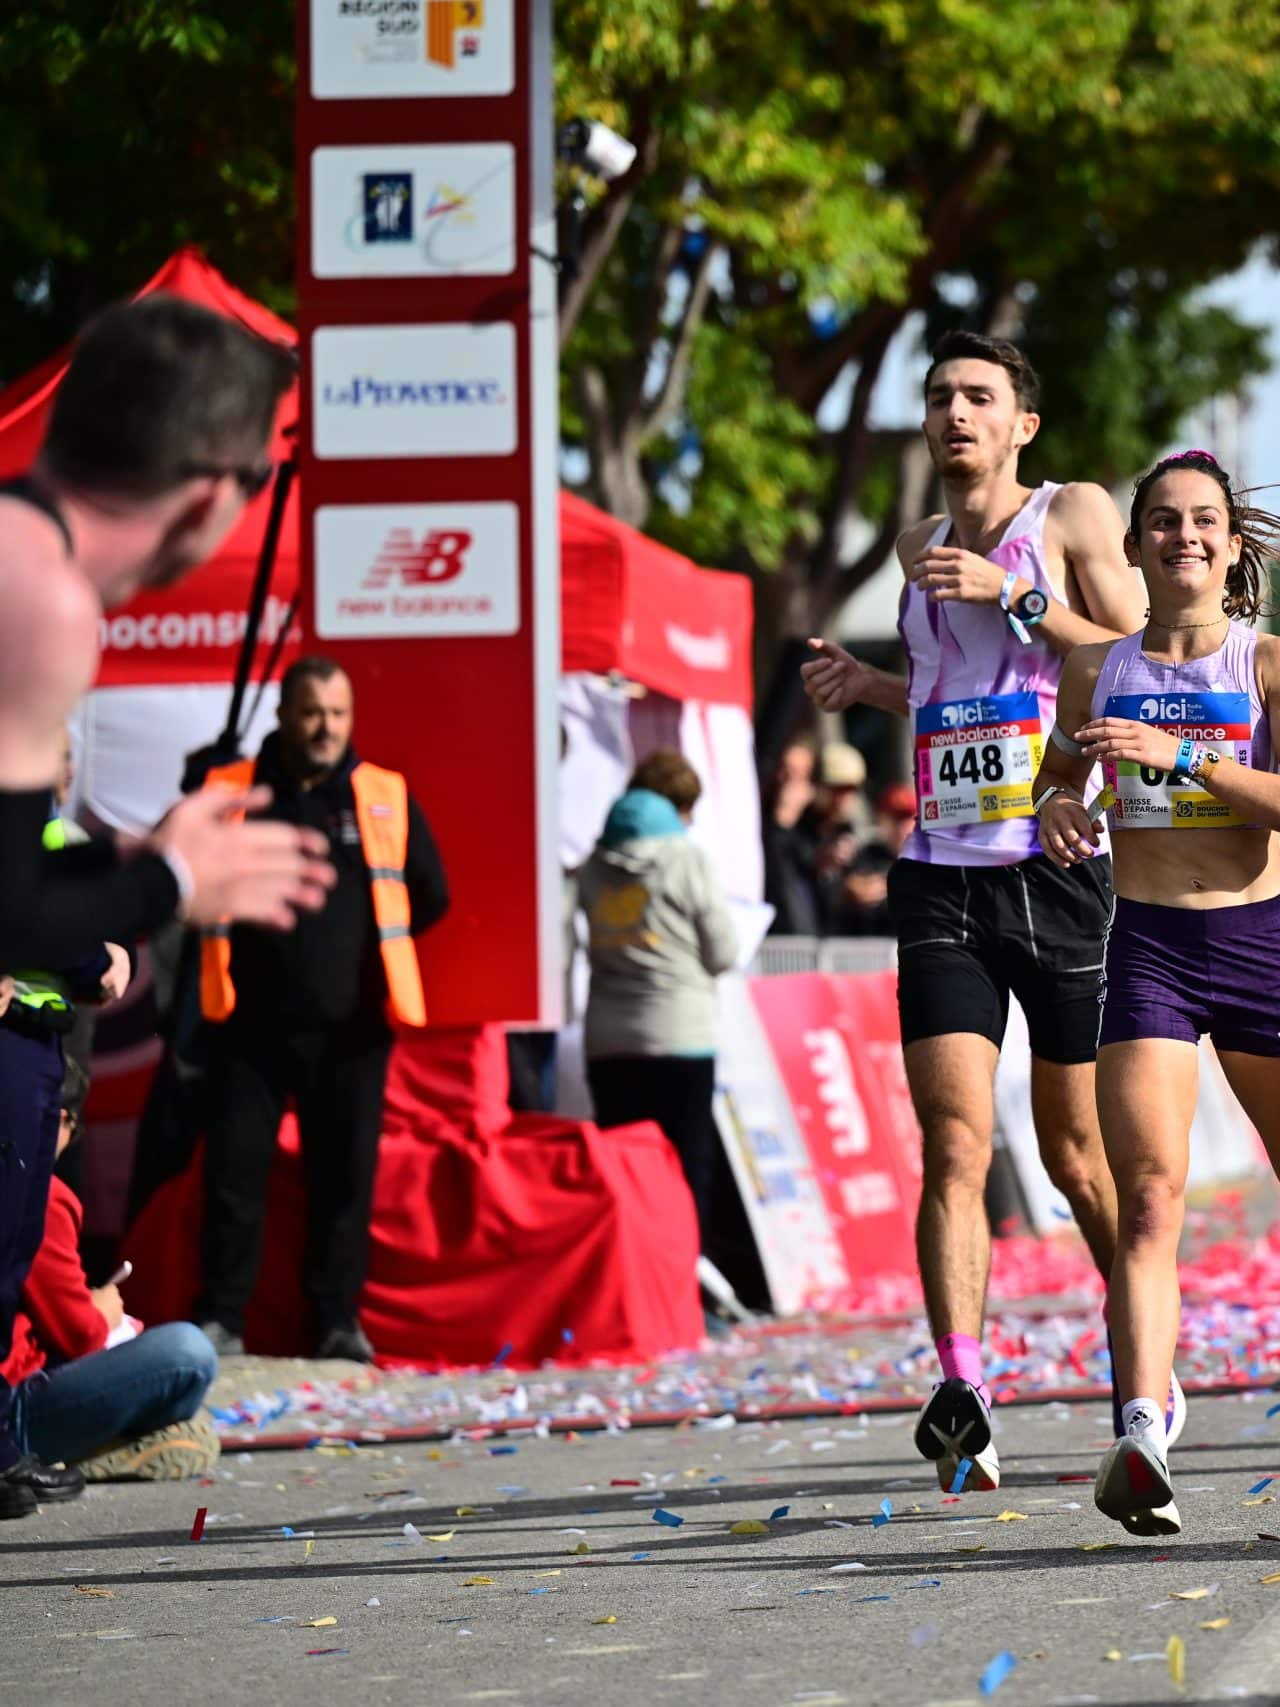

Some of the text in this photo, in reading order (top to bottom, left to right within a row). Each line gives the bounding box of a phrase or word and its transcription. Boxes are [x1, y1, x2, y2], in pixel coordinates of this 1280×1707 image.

[390, 594, 493, 618] balance
[958, 701, 983, 725] ici
[1160, 698, 1187, 720] ici
[931, 724, 1021, 747] new balance
[939, 745, 1004, 787] 448
[1123, 798, 1152, 806] CAISSE
